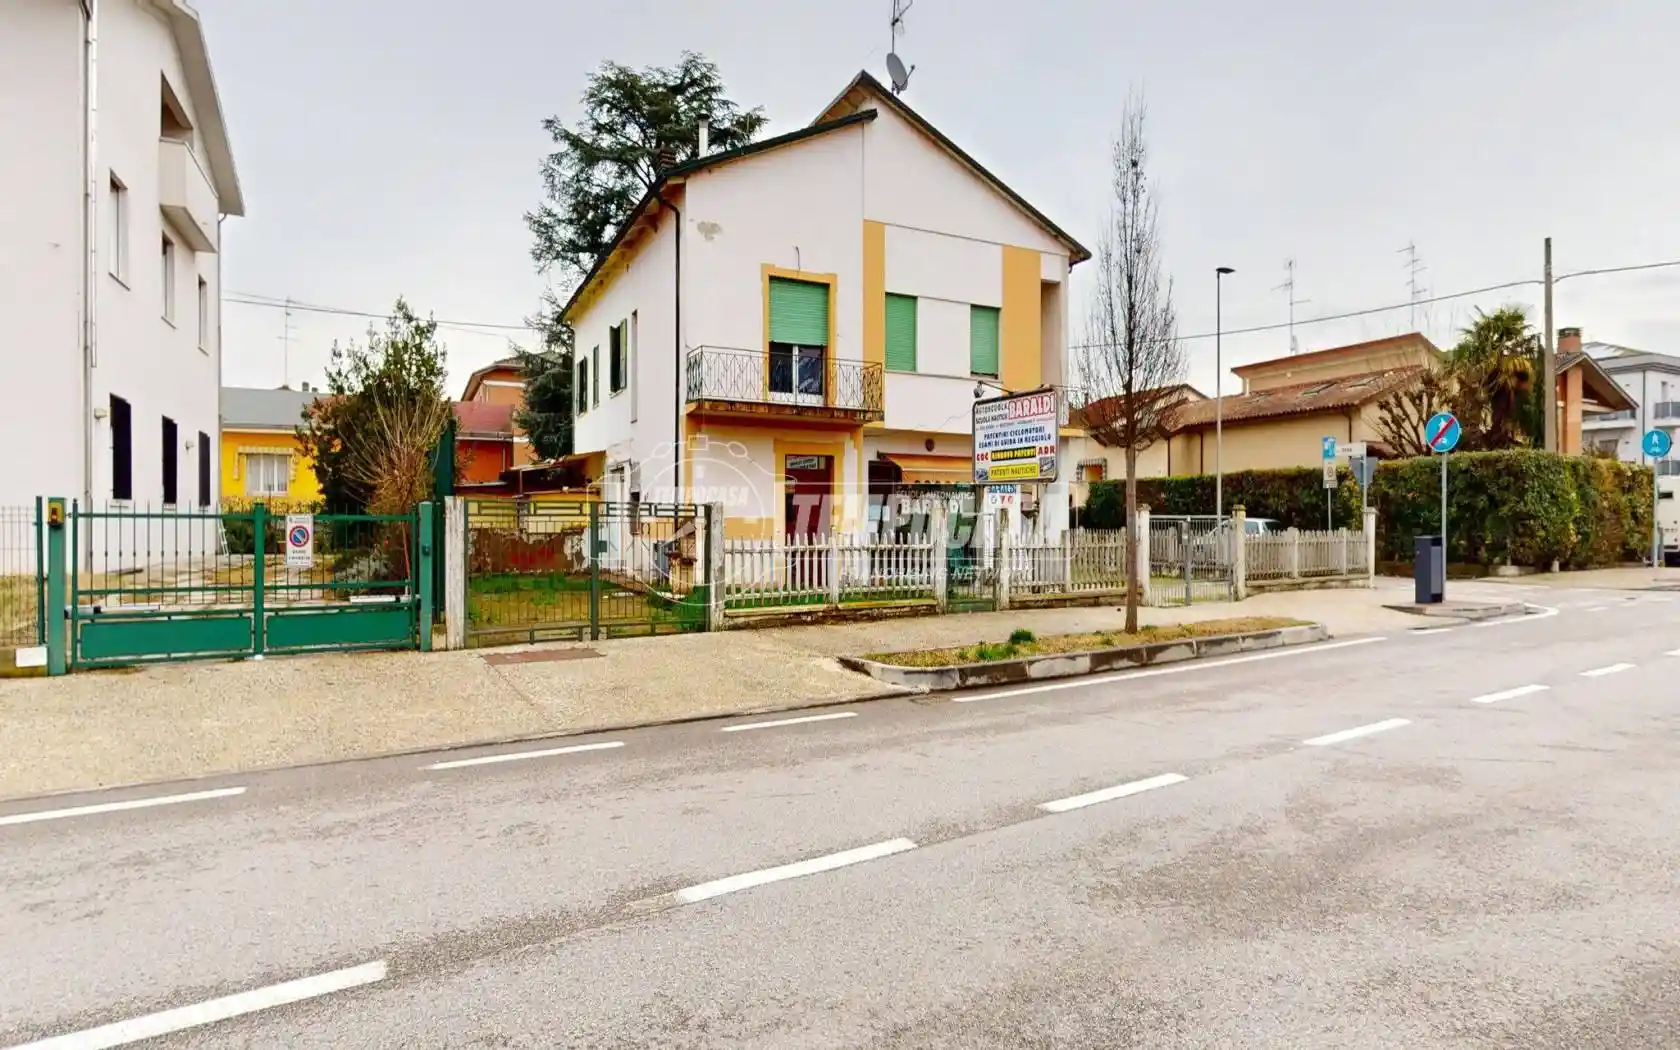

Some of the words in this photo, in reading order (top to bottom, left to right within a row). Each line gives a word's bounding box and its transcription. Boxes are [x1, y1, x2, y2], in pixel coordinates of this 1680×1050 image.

[976, 403, 1007, 414] AUTOSCUOLA
[1008, 393, 1055, 420] BARALDI
[976, 416, 990, 425] SCUOLA
[991, 414, 1007, 423] NAUTICA
[984, 431, 1009, 439] PATENTINI
[1010, 426, 1045, 437] CICLOMOTORI
[979, 441, 993, 449] ESAMI
[1001, 438, 1016, 446] GUIDA
[1024, 433, 1051, 443] REGGIOLO
[992, 450, 1013, 461] RINNOVO
[1014, 447, 1036, 459] PATENTI
[1038, 445, 1055, 456] ADR
[991, 468, 1009, 477] PATENTI
[1011, 465, 1036, 475] NAUTICHE
[896, 489, 924, 498] SCUOLA
